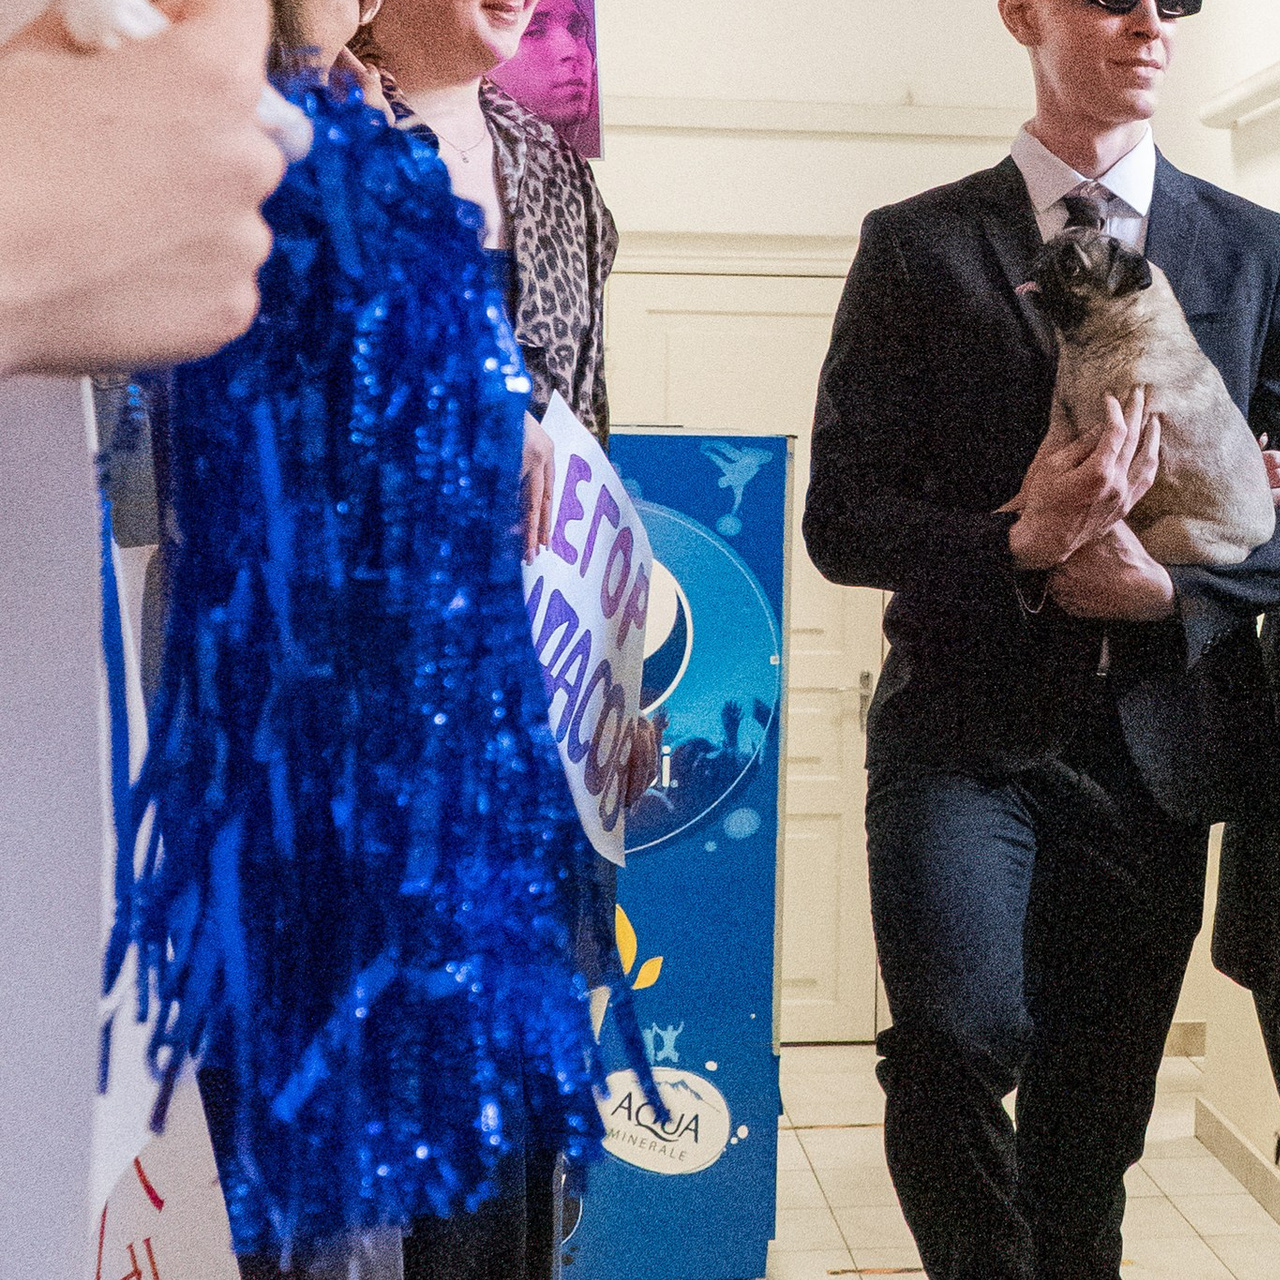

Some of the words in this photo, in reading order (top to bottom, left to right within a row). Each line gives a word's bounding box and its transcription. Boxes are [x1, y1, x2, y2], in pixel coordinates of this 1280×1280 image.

[551, 453, 651, 651] ЕГОР
[611, 1091, 699, 1144] AQUA
[607, 1128, 688, 1162] MINERALE
